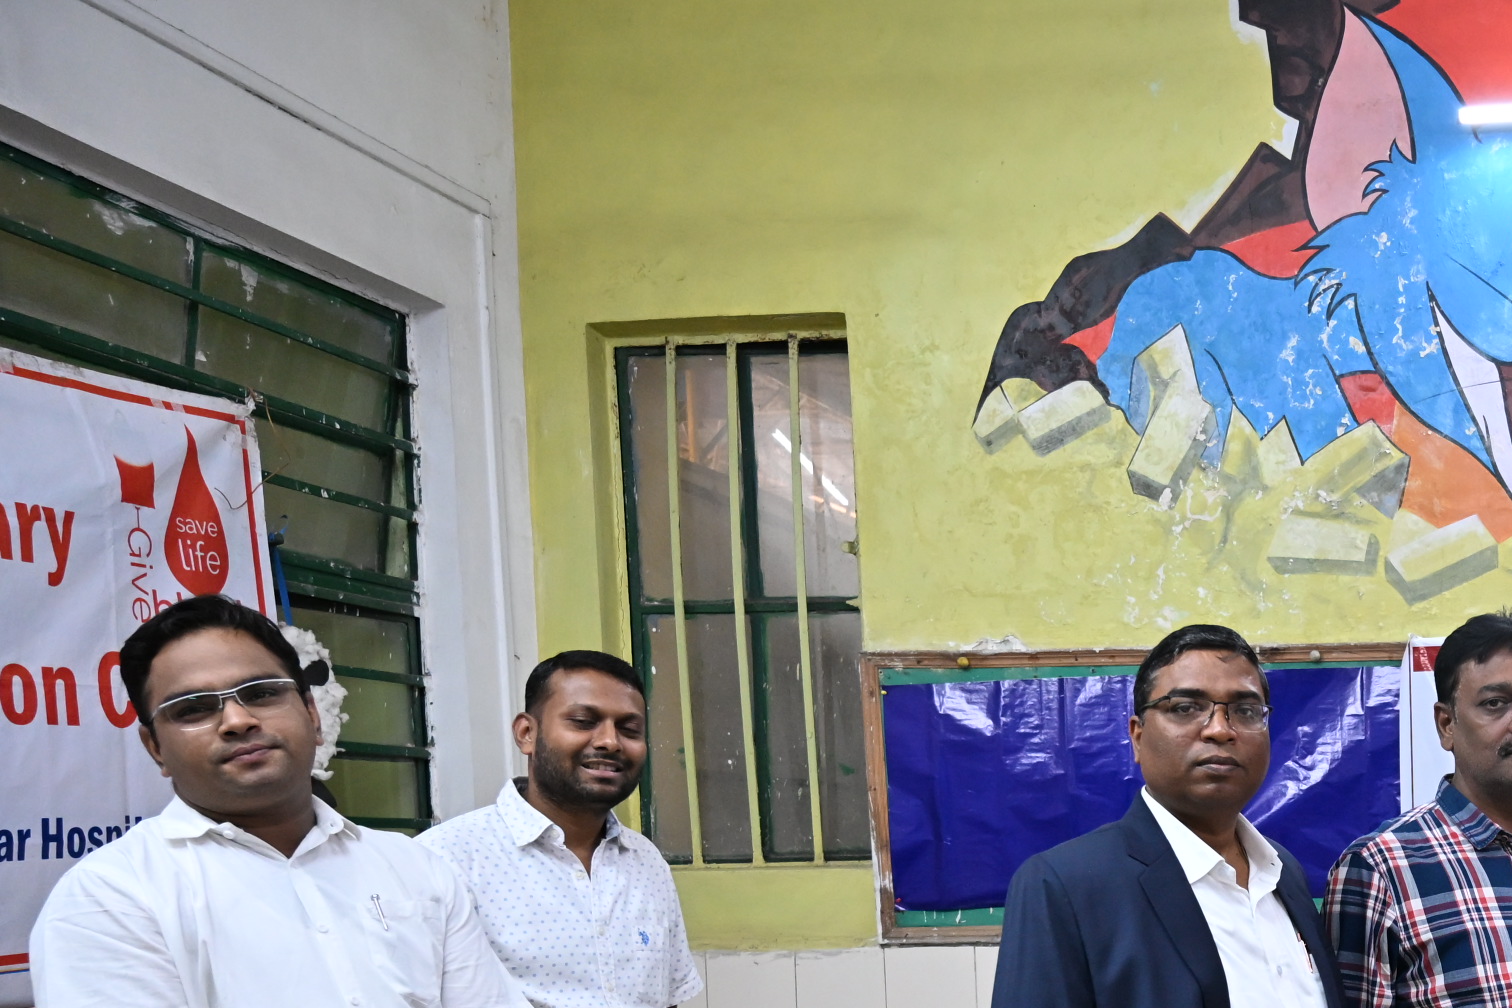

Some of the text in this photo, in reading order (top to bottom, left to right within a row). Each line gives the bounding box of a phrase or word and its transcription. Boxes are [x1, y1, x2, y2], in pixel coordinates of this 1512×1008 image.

[176, 517, 218, 537] save
[127, 527, 154, 623] Give
[178, 538, 221, 575] life
